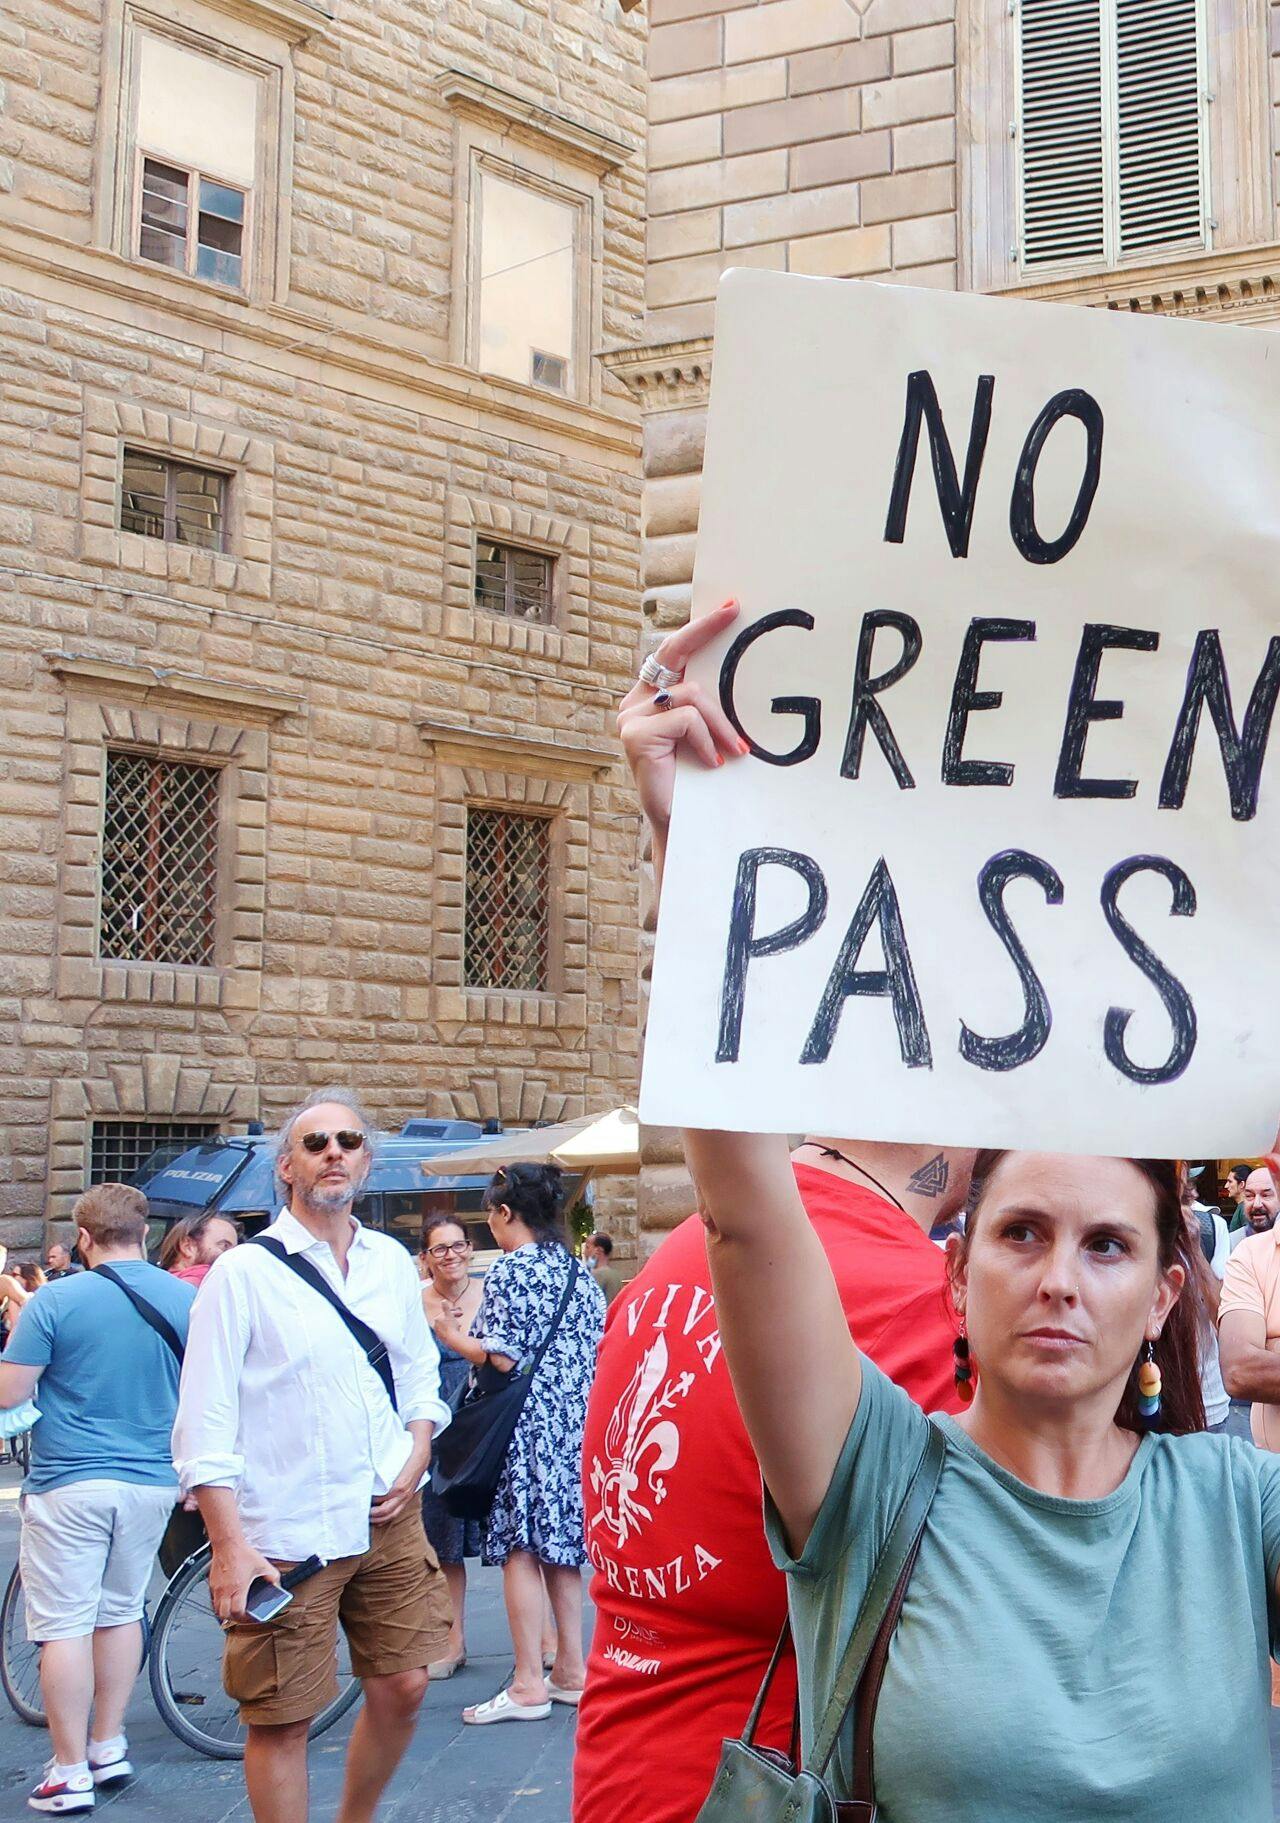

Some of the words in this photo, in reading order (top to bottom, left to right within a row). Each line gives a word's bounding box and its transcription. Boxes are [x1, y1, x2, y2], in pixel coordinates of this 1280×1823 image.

[886, 370, 1104, 565] NO
[715, 848, 1198, 1086] PASS
[162, 1169, 223, 1183] POLIZIA
[627, 1284, 721, 1374] VIVA
